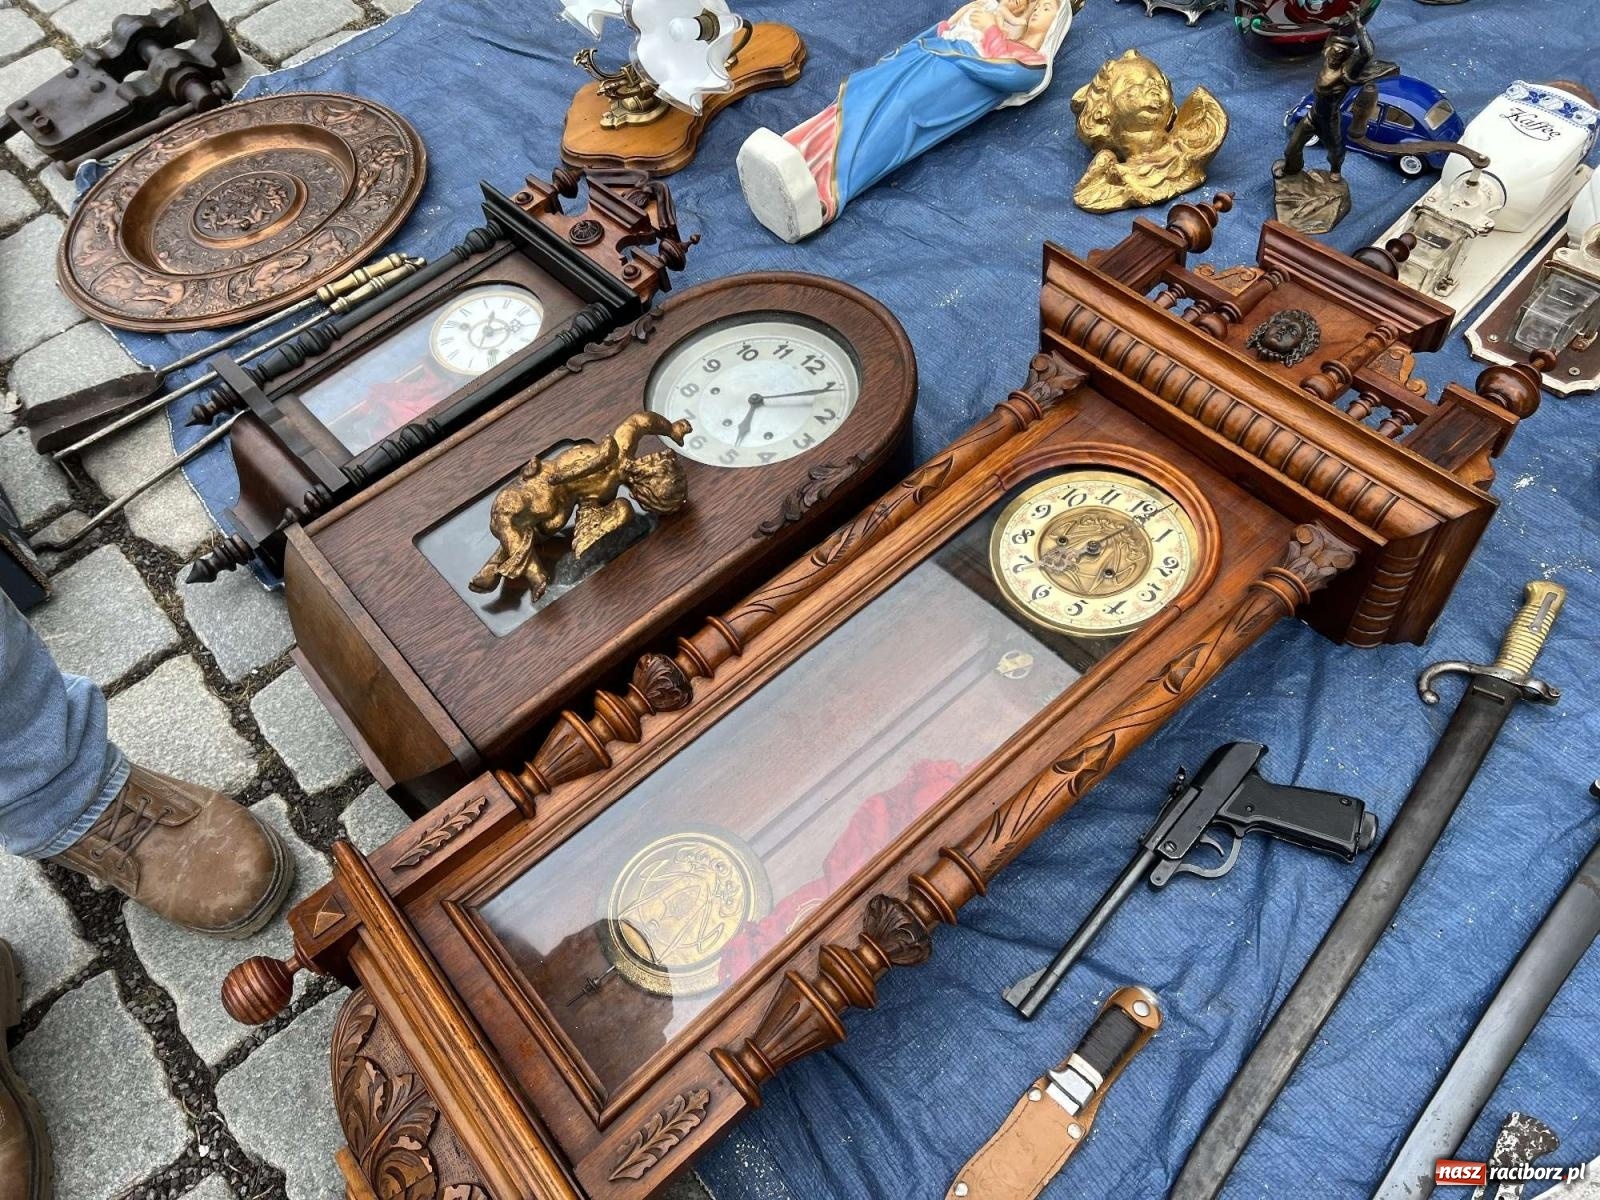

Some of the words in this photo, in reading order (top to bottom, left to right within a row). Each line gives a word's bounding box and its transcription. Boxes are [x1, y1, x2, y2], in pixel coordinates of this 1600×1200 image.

[1499, 107, 1561, 141] Kaffee
[736, 344, 759, 362] 10
[772, 344, 794, 359] 11
[702, 358, 721, 373] 9
[801, 355, 826, 375] 12
[680, 383, 699, 397] 8
[813, 408, 836, 425] 2
[689, 435, 707, 450] 6
[793, 432, 816, 450] 3
[719, 449, 740, 464] 5
[756, 451, 778, 463] 4
[1057, 487, 1088, 507] 10
[1094, 488, 1121, 505] 11
[1031, 504, 1052, 519] 9
[1011, 528, 1035, 545] 8
[1151, 529, 1173, 542] 1
[1154, 556, 1180, 577] 2
[1031, 585, 1052, 601] 6
[1139, 582, 1162, 602] 3
[1065, 599, 1089, 616] 5
[1102, 600, 1128, 616] 4
